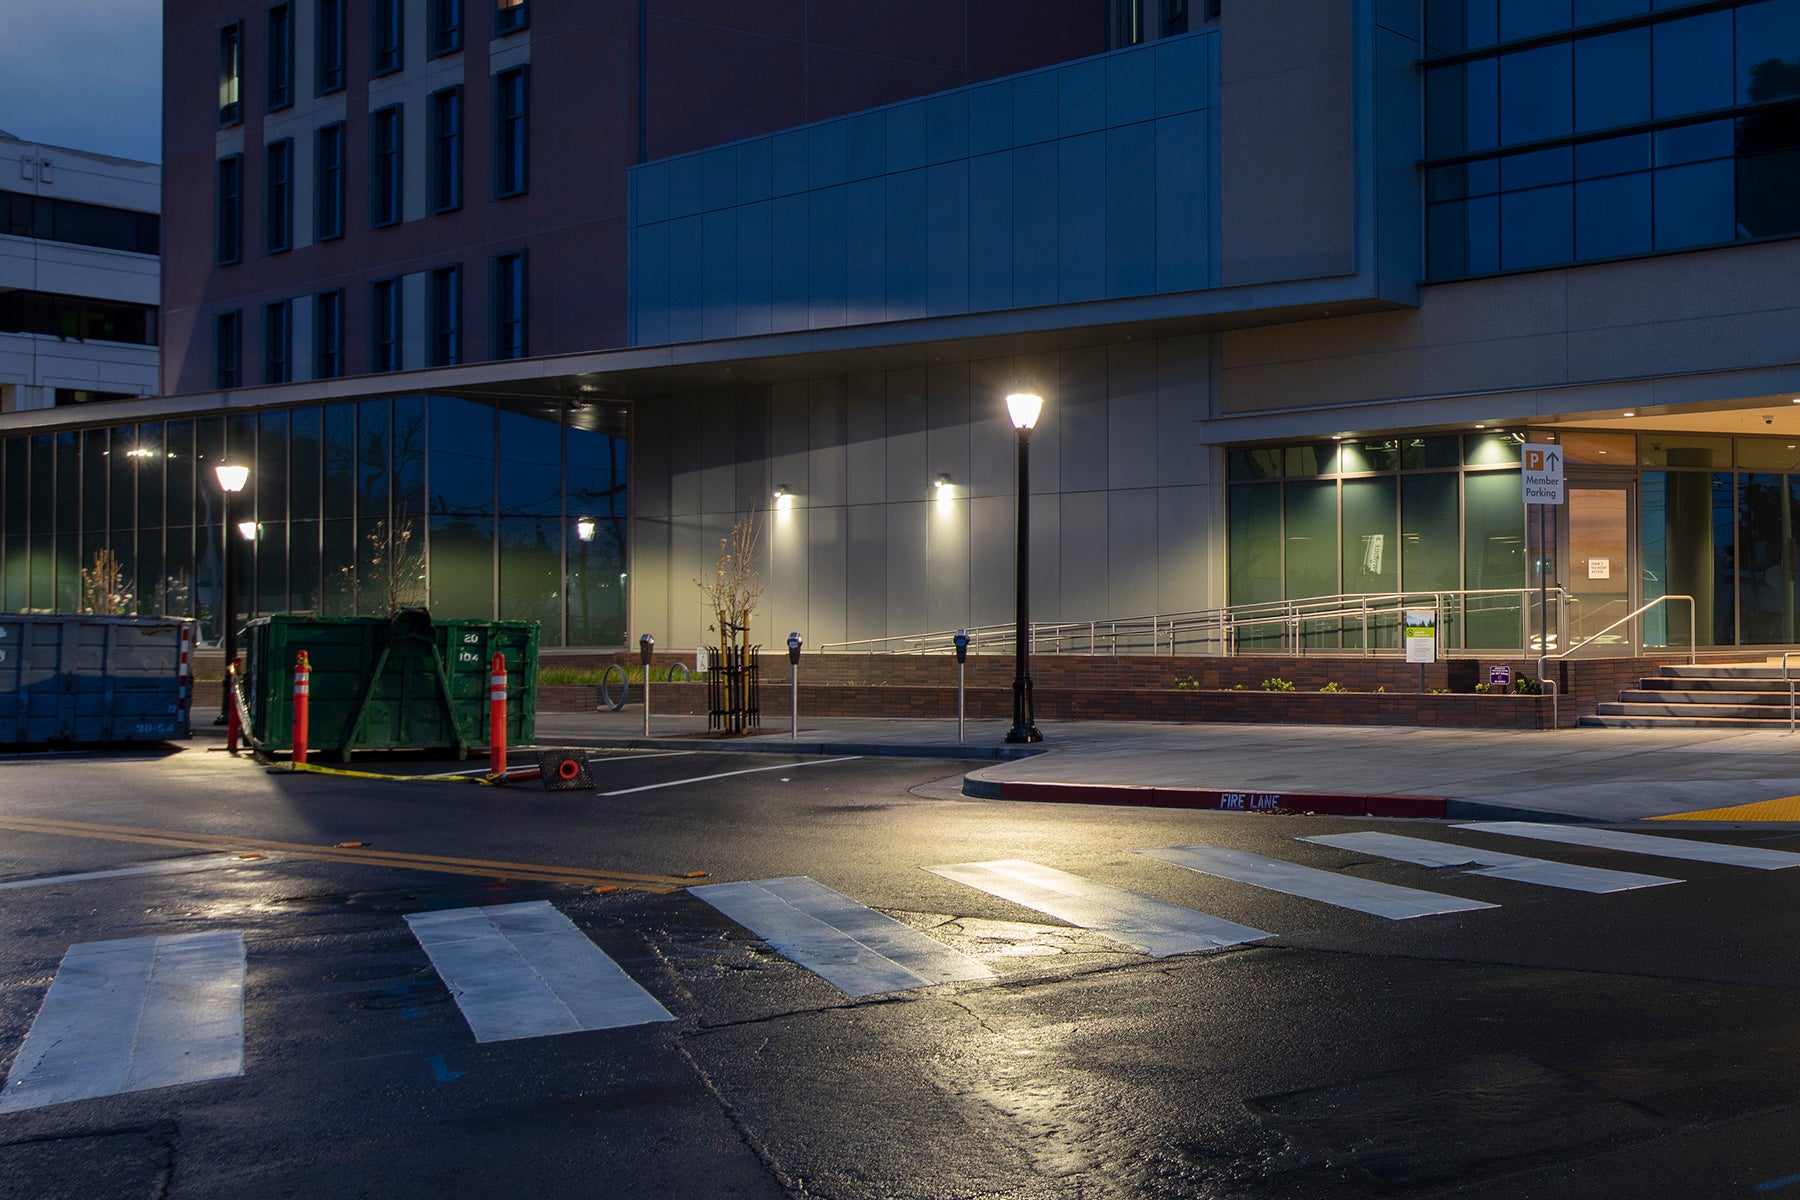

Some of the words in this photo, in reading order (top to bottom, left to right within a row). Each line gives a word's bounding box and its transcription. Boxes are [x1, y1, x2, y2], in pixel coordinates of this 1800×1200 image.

[1530, 453, 1540, 468] P
[1526, 475, 1559, 486] Member
[1526, 487, 1556, 500] Parking
[464, 634, 479, 643] 20
[460, 653, 479, 661] 104
[1220, 793, 1246, 809] FIRE
[1250, 794, 1280, 809] LANE
